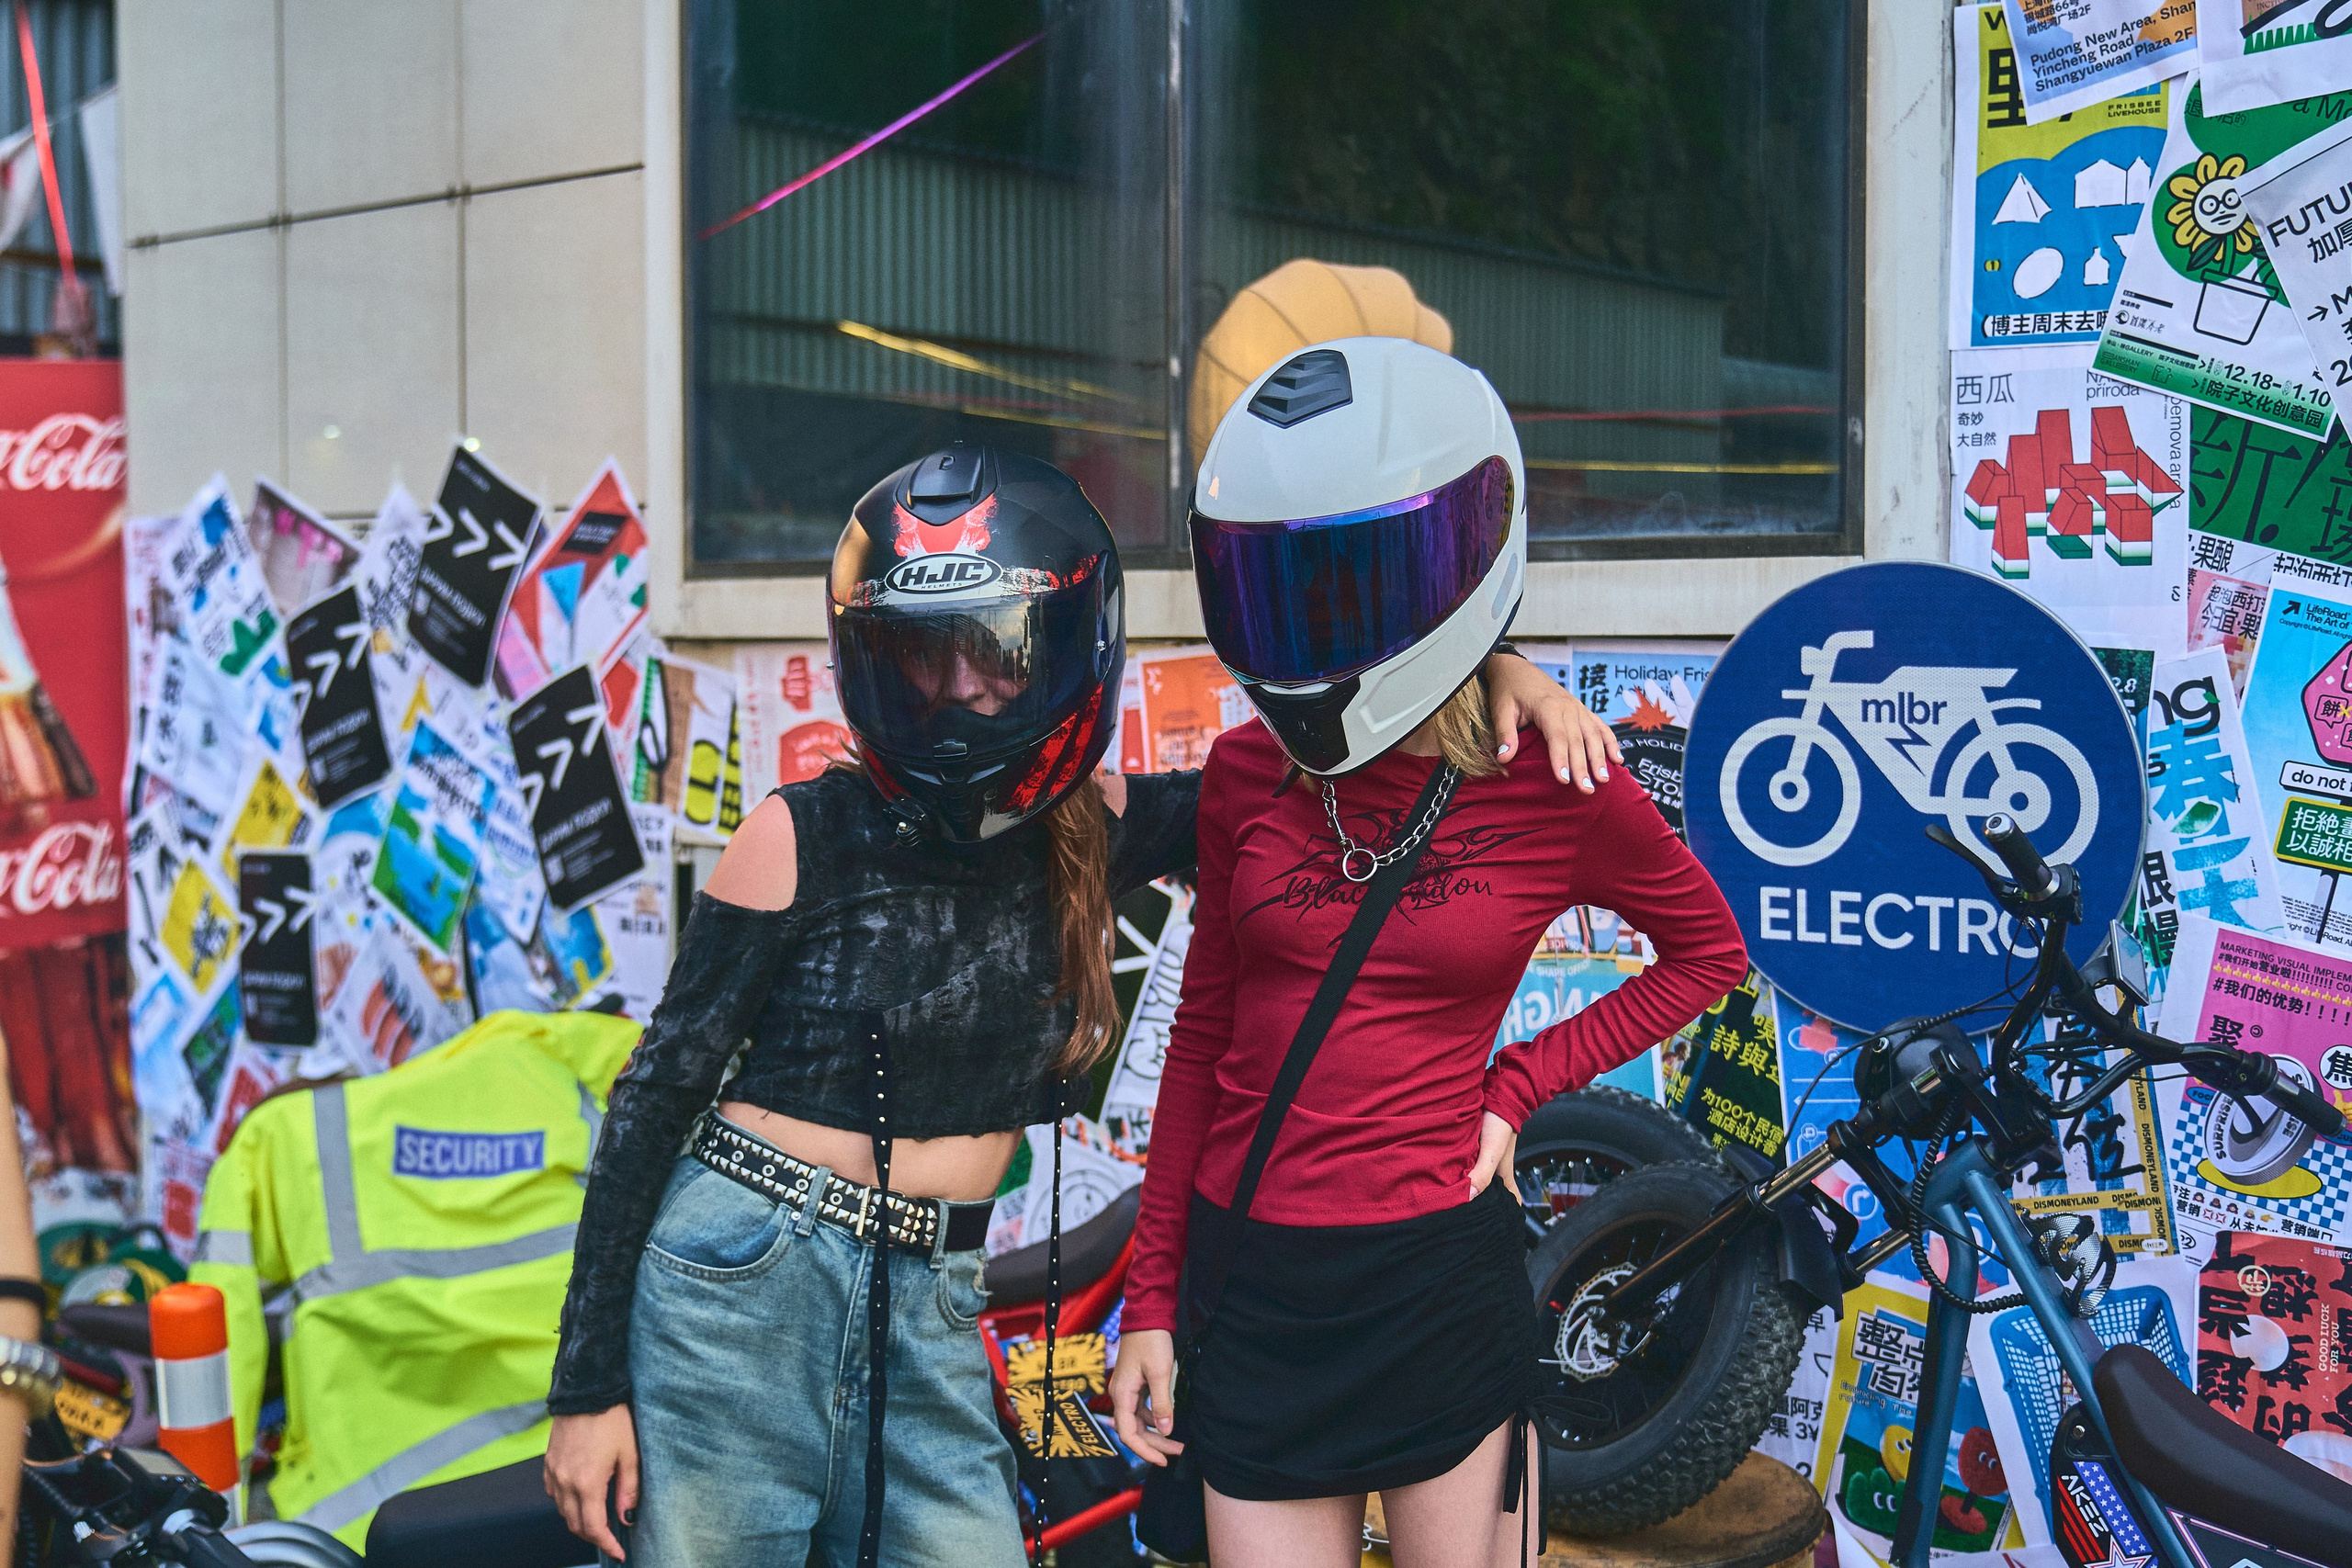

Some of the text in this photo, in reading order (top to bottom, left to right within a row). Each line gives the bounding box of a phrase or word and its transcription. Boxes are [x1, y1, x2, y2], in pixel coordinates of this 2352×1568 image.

[2030, 39, 2083, 66] Pudong
[2086, 28, 2117, 47] New
[2121, 16, 2157, 35] Area,
[2033, 35, 2134, 79] Yincheng Road
[2035, 27, 2194, 92] Shangyuewan Plaza 2F
[2108, 100, 2161, 110] FRISBEE
[2108, 107, 2161, 118] LIVEHOUSE
[1956, 374, 2015, 405] 西瓜
[2206, 379, 2325, 429] 院子文化创意园
[2292, 383, 2332, 408] 1.10
[1958, 412, 1984, 427] 奇妙
[1957, 433, 1997, 447] 大自然
[899, 562, 986, 588] HJC
[2279, 617, 2303, 629] Copyright
[2306, 613, 2350, 629] The Art of
[1614, 665, 1679, 684] Holiday
[1861, 692, 1948, 726] mlbr
[2291, 770, 2346, 792] do not
[2220, 942, 2275, 962] MARKETING
[2277, 956, 2311, 973] VISUAL
[1701, 1087, 1784, 1145] 为100个民宿
[2212, 1097, 2233, 1159] SURPRISE
[398, 1131, 541, 1174] SECURITY
[2142, 1122, 2159, 1192] DISMONEYLAND
[2033, 1196, 2099, 1209] DISMONEYLAND
[2318, 1303, 2330, 1371] GOOD LUCK
[2329, 1321, 2339, 1373] FOR YOU
[1840, 1380, 1913, 1417] Embracing The
[1059, 1403, 1099, 1444] ELECTRO
